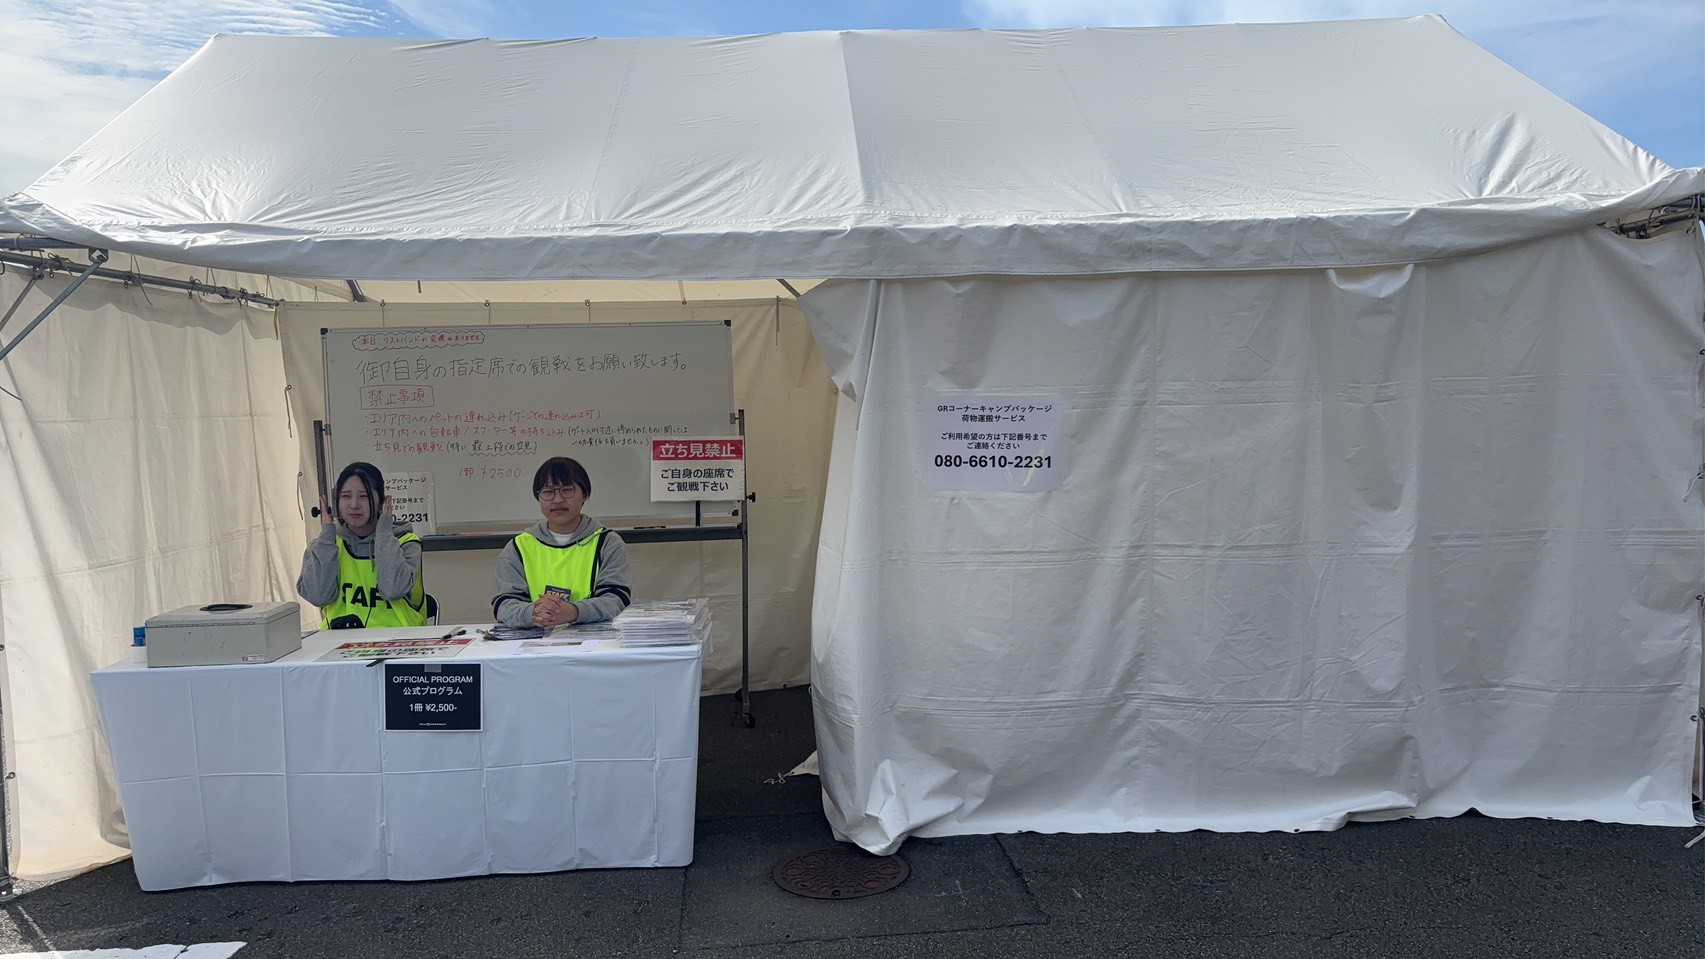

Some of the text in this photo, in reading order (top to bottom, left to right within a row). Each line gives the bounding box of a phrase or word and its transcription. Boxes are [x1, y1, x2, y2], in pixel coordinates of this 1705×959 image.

[361, 337, 376, 346] 本日
[356, 353, 687, 384] 御自身の指定席での観戦をお願い致します。
[368, 388, 425, 407] 禁止事項
[961, 414, 1026, 423] 荷物運搬サービス
[941, 432, 1048, 441] ご利用希望の方は下記番号まで
[659, 443, 737, 458] 立ち見禁止
[966, 442, 1021, 450] ご連絡ください
[934, 454, 1051, 469] 080-6610-2231
[660, 467, 735, 480] ご自身の座席で
[667, 481, 729, 493] ご観戦下さい
[392, 675, 473, 684] OFFICIAL PROGRAM
[402, 686, 463, 696] 公式プログラム
[409, 703, 457, 713] 1冊 ¥2,500-
